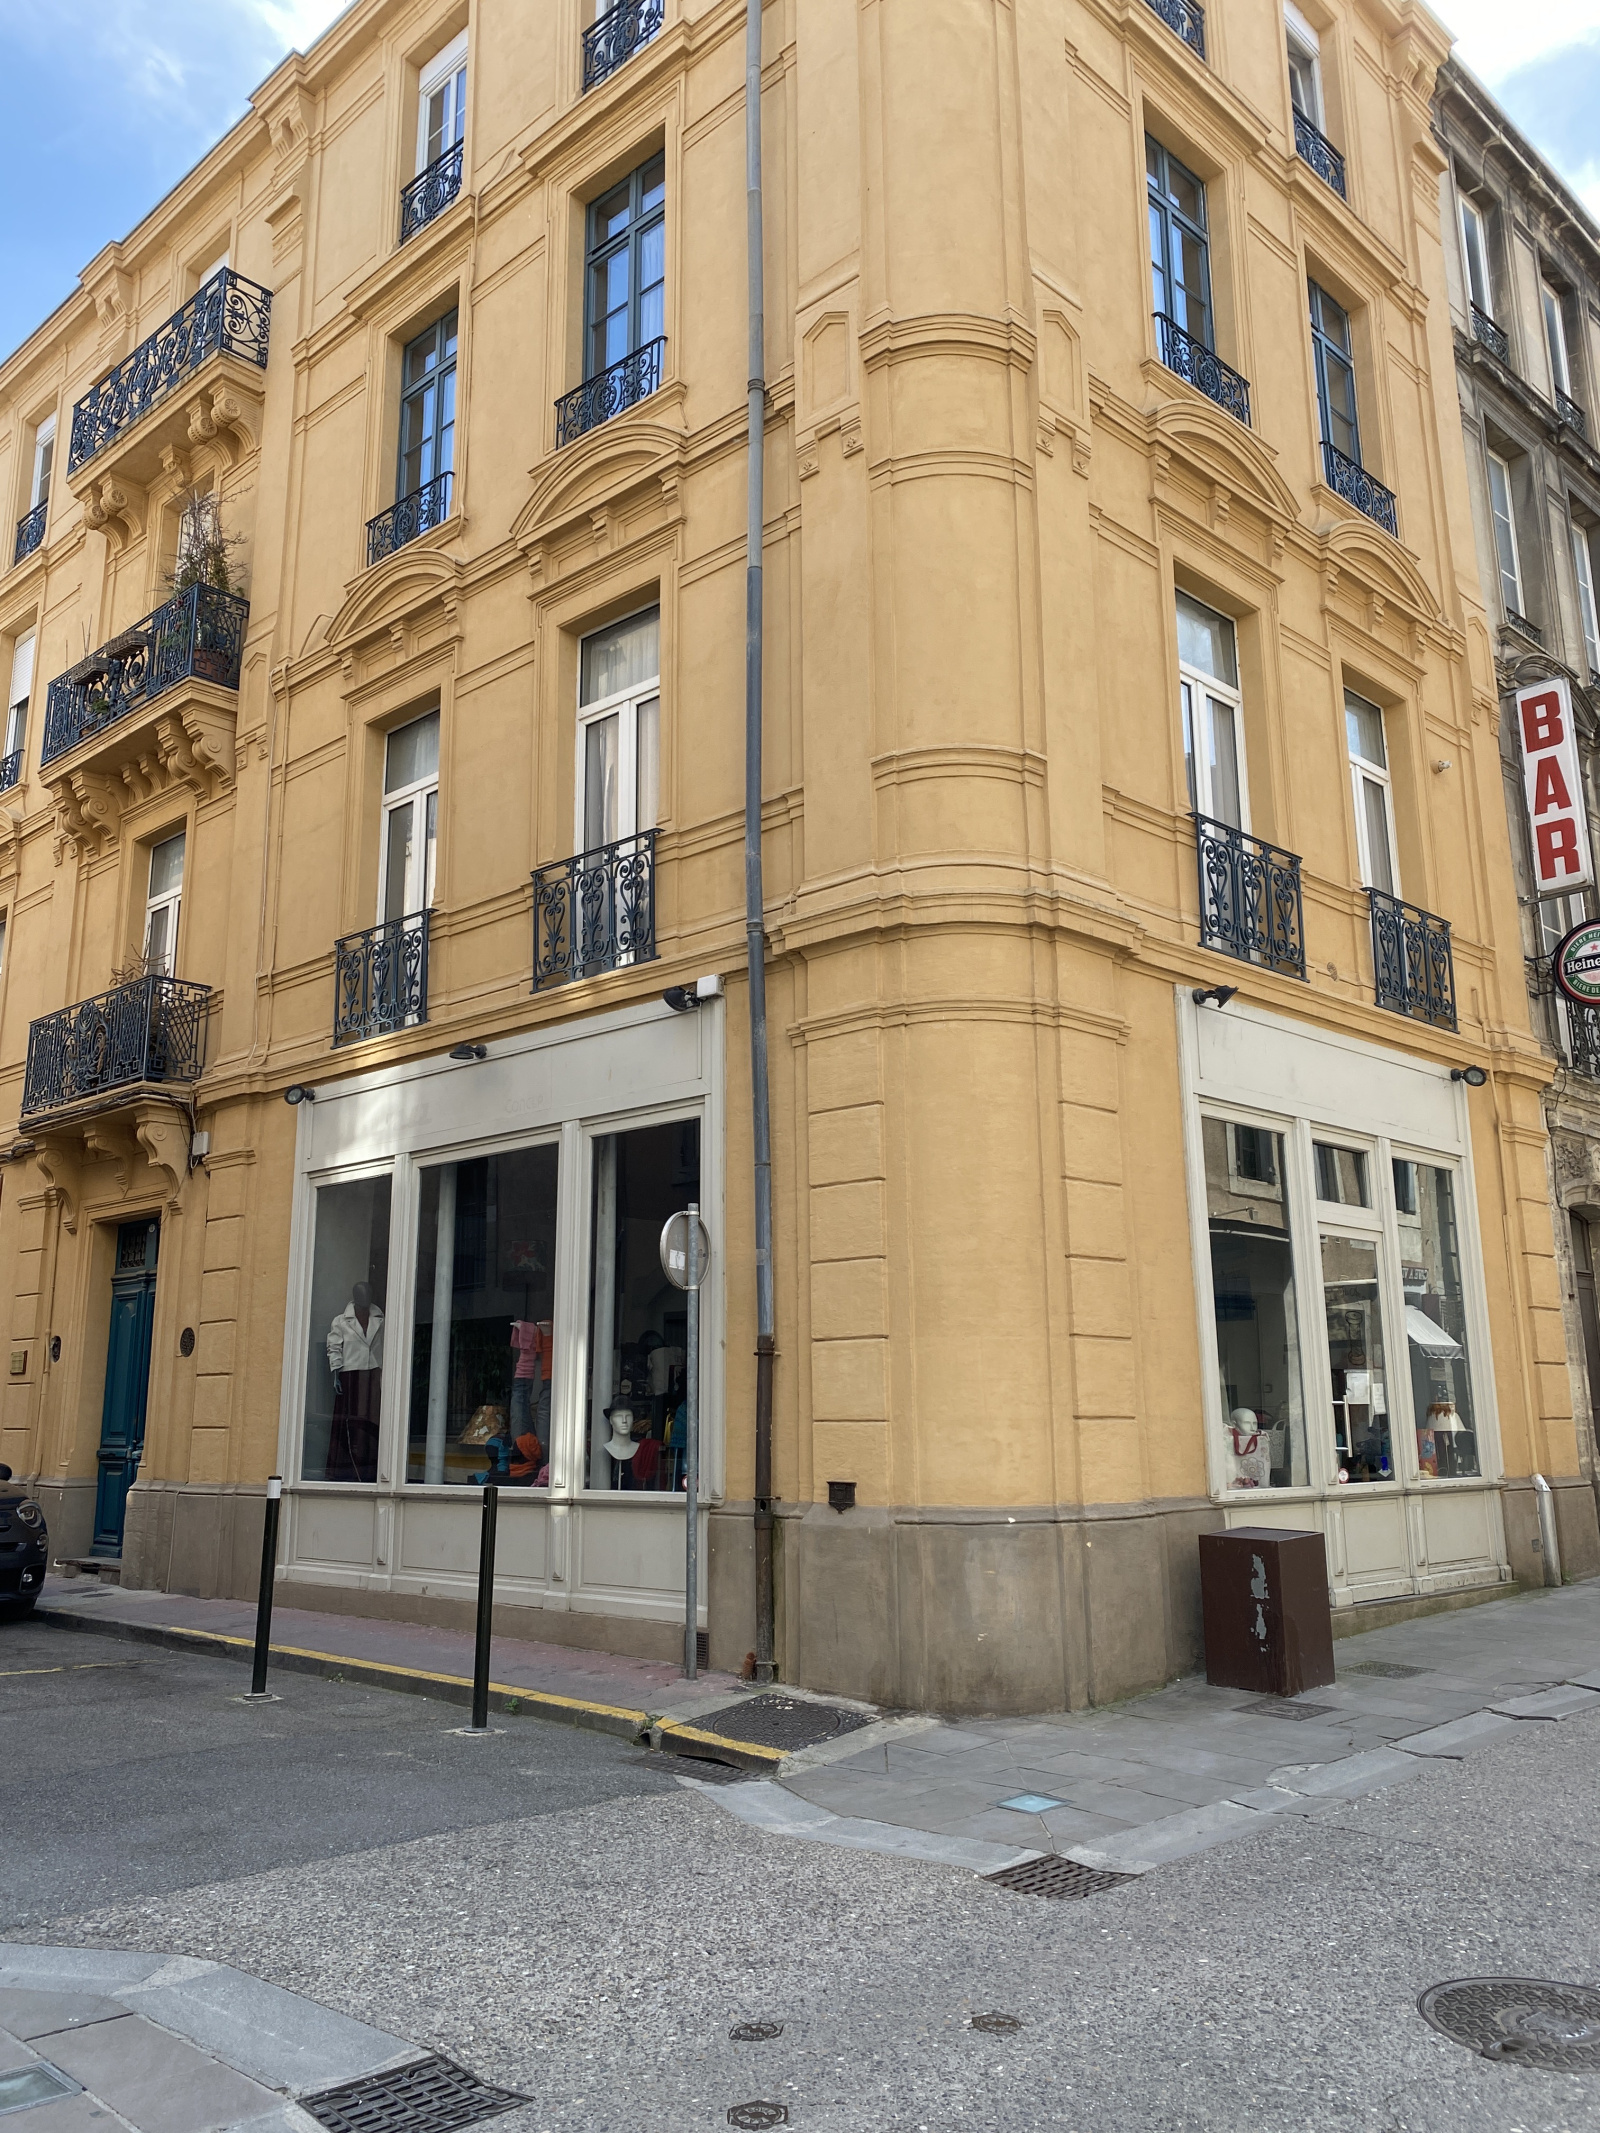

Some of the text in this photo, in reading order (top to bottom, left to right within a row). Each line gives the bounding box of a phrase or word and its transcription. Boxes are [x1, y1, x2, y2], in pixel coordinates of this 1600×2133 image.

[1520, 690, 1581, 881] BAR
[1570, 937, 1587, 951] BIERE
[1572, 979, 1590, 993] BIERE
